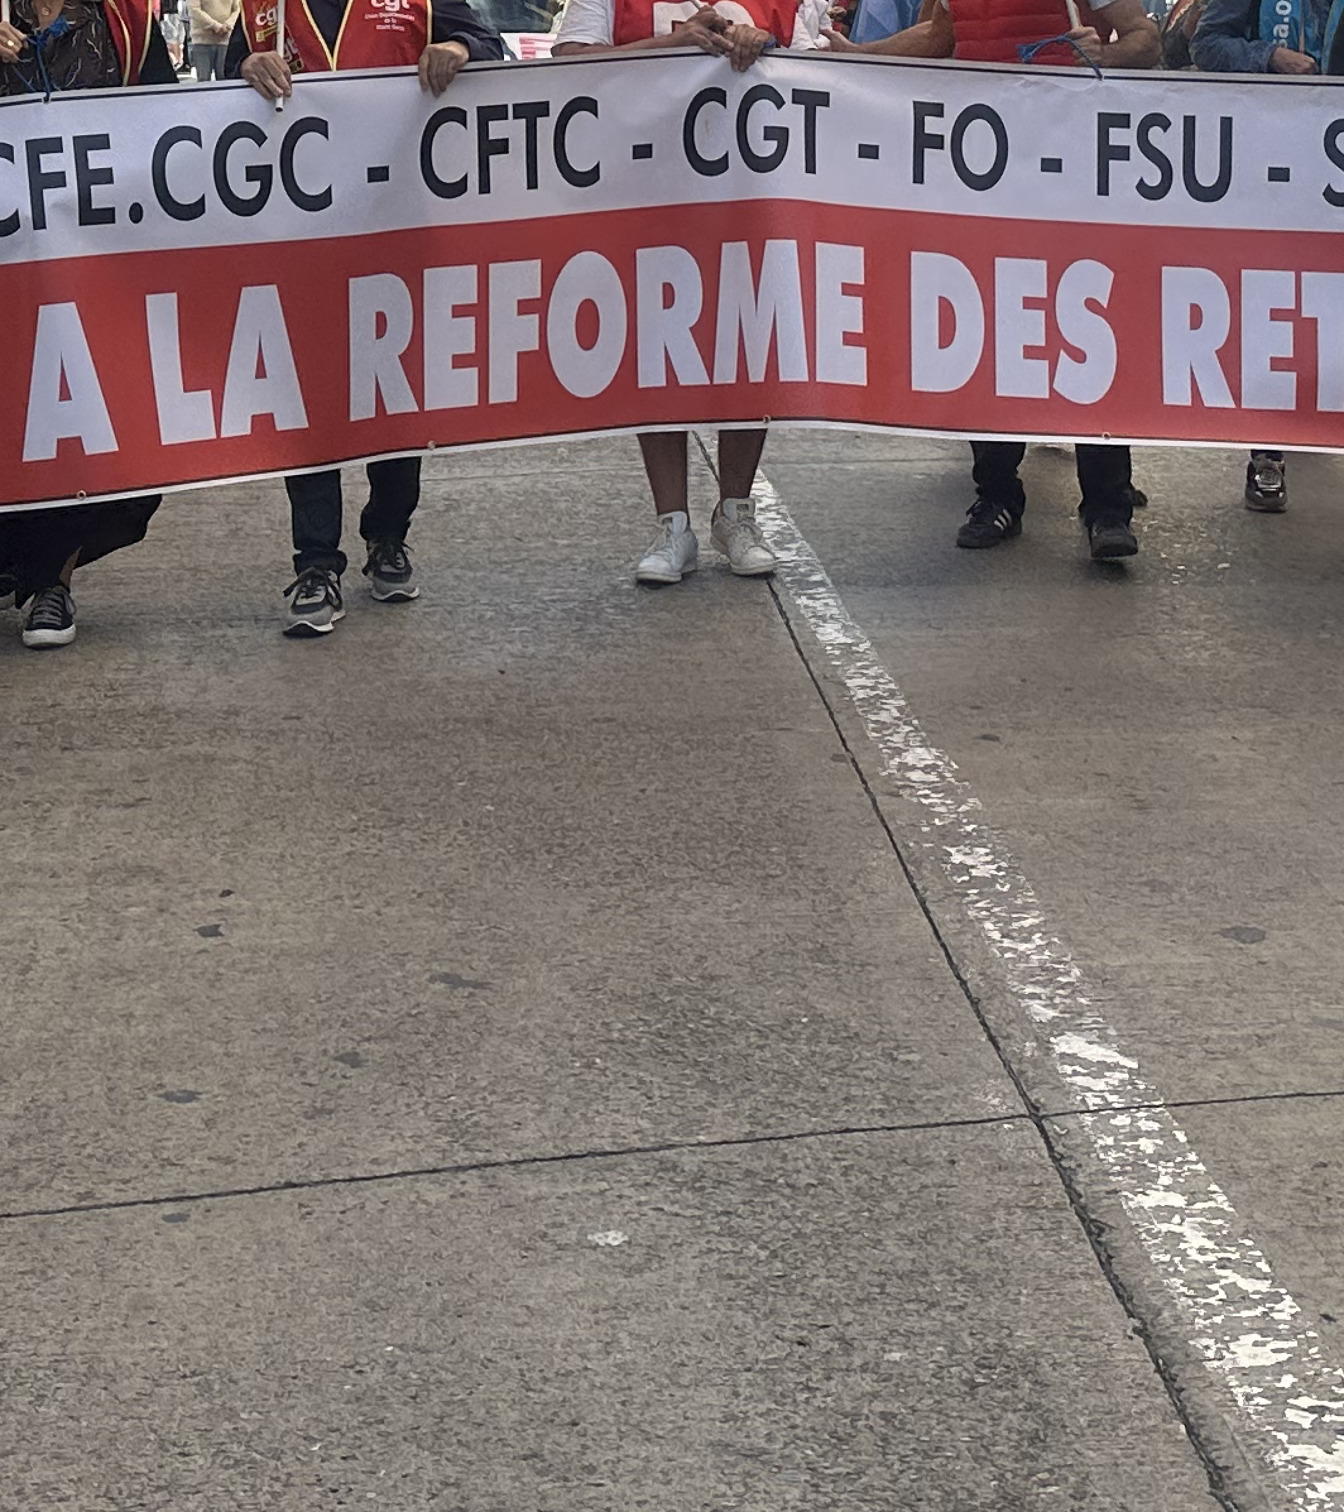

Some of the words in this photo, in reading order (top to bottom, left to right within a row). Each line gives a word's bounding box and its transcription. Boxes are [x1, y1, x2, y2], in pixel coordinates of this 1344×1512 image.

[255, 7, 278, 26] cg
[420, 95, 601, 199] CFTC
[683, 84, 830, 177] CGT
[912, 100, 1009, 192] FO
[1096, 112, 1233, 203] FSU
[23, 302, 119, 463] A
[145, 283, 309, 446] LA
[348, 238, 869, 423] REFORME
[910, 250, 1118, 406] DES
